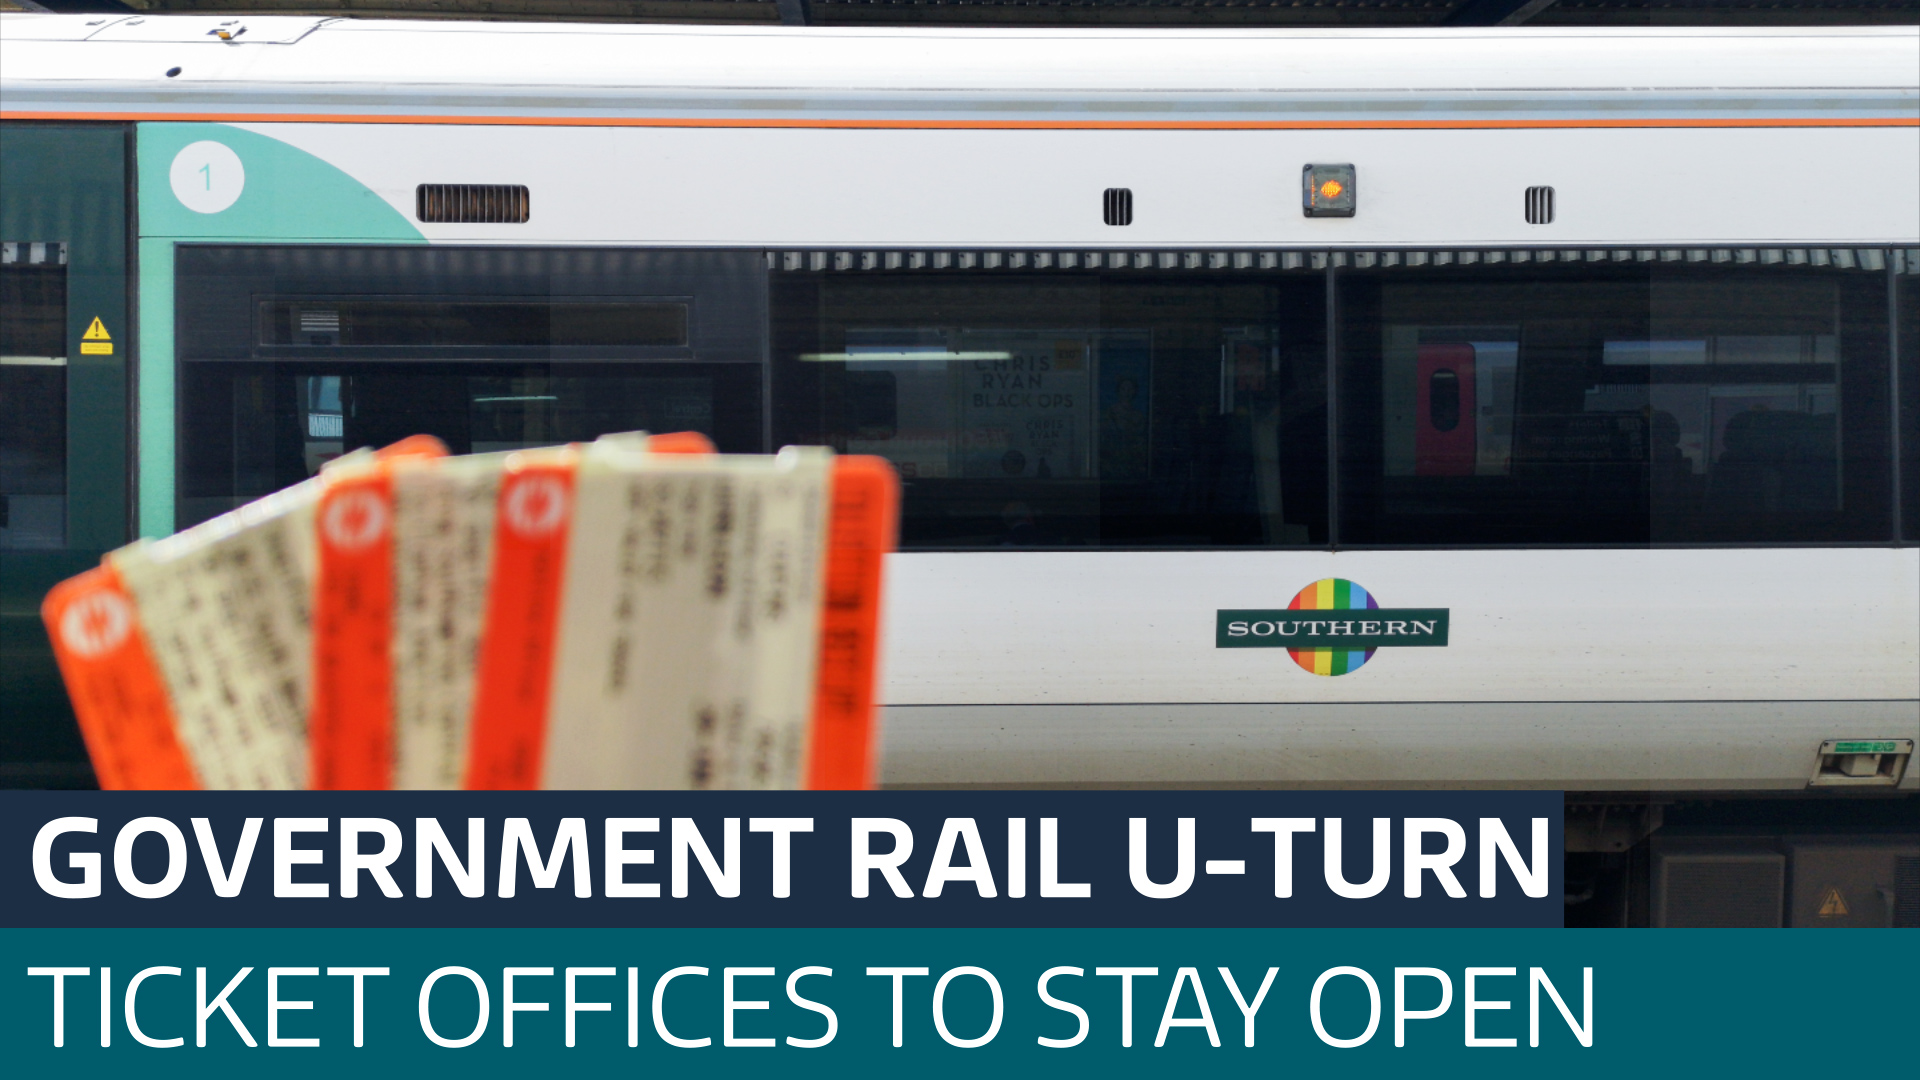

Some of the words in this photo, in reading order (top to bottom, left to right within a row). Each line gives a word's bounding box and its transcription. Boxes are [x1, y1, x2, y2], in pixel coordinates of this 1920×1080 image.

[198, 163, 211, 191] 1
[974, 356, 1051, 371] CHRIS
[982, 374, 1042, 389] RYAN
[973, 393, 1032, 408] BLACK
[1038, 393, 1074, 408] OPS
[1227, 620, 1437, 636] SOUTHERN
